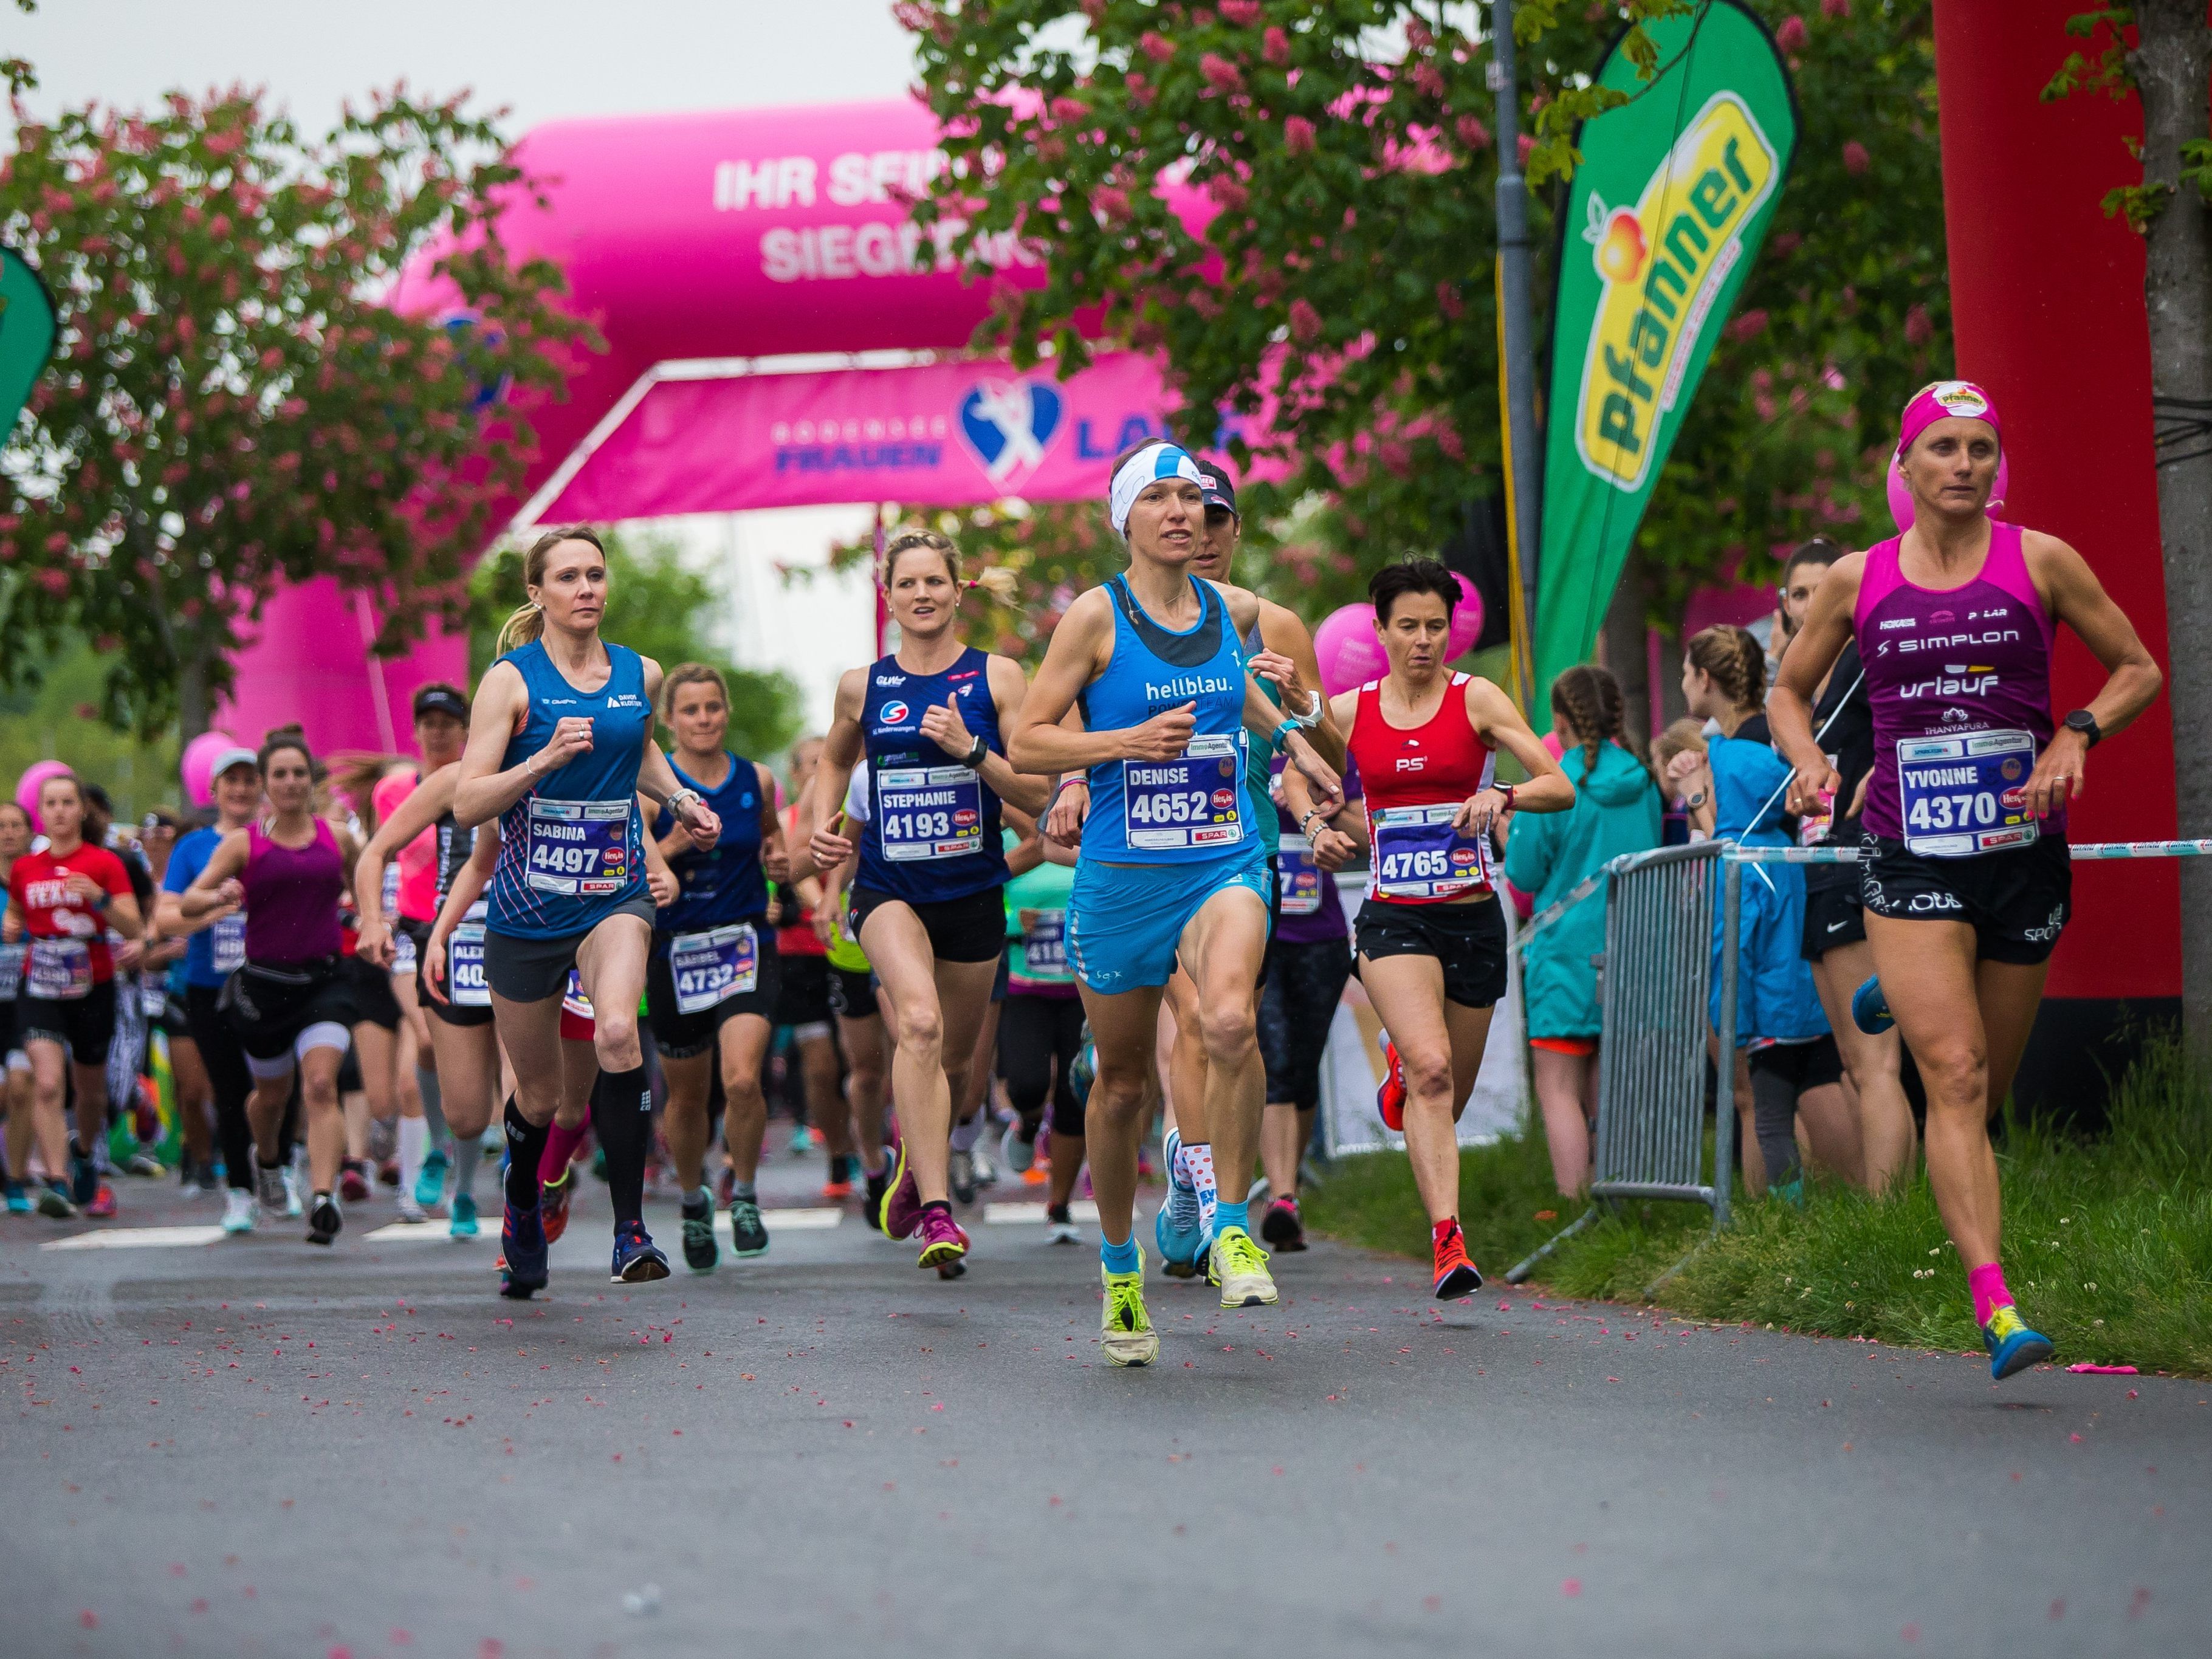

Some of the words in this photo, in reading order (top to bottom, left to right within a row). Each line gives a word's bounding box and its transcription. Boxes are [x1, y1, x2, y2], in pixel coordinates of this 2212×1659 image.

[713, 156, 817, 211] IHR
[1598, 135, 1753, 455] Pfanner
[1898, 630, 2019, 653] SIMPLON
[1146, 675, 1234, 701] hellblau.
[1924, 721, 1990, 736] THANYAPURA
[1130, 767, 1189, 786] DENISE
[1905, 766, 1979, 789] YVONNE
[883, 791, 957, 809] STEPHANIE
[1132, 791, 1208, 823] 4652
[1213, 794, 1232, 804] Hervis
[1909, 792, 1996, 829] 4370
[534, 823, 586, 841] SABINA
[885, 812, 949, 839] 4193
[1202, 830, 1227, 840] SPAR
[1989, 833, 2022, 844] SPAR
[532, 845, 599, 873] 4497
[1381, 850, 1448, 879] 4765
[456, 964, 489, 987] 40
[679, 963, 733, 993] 4732
